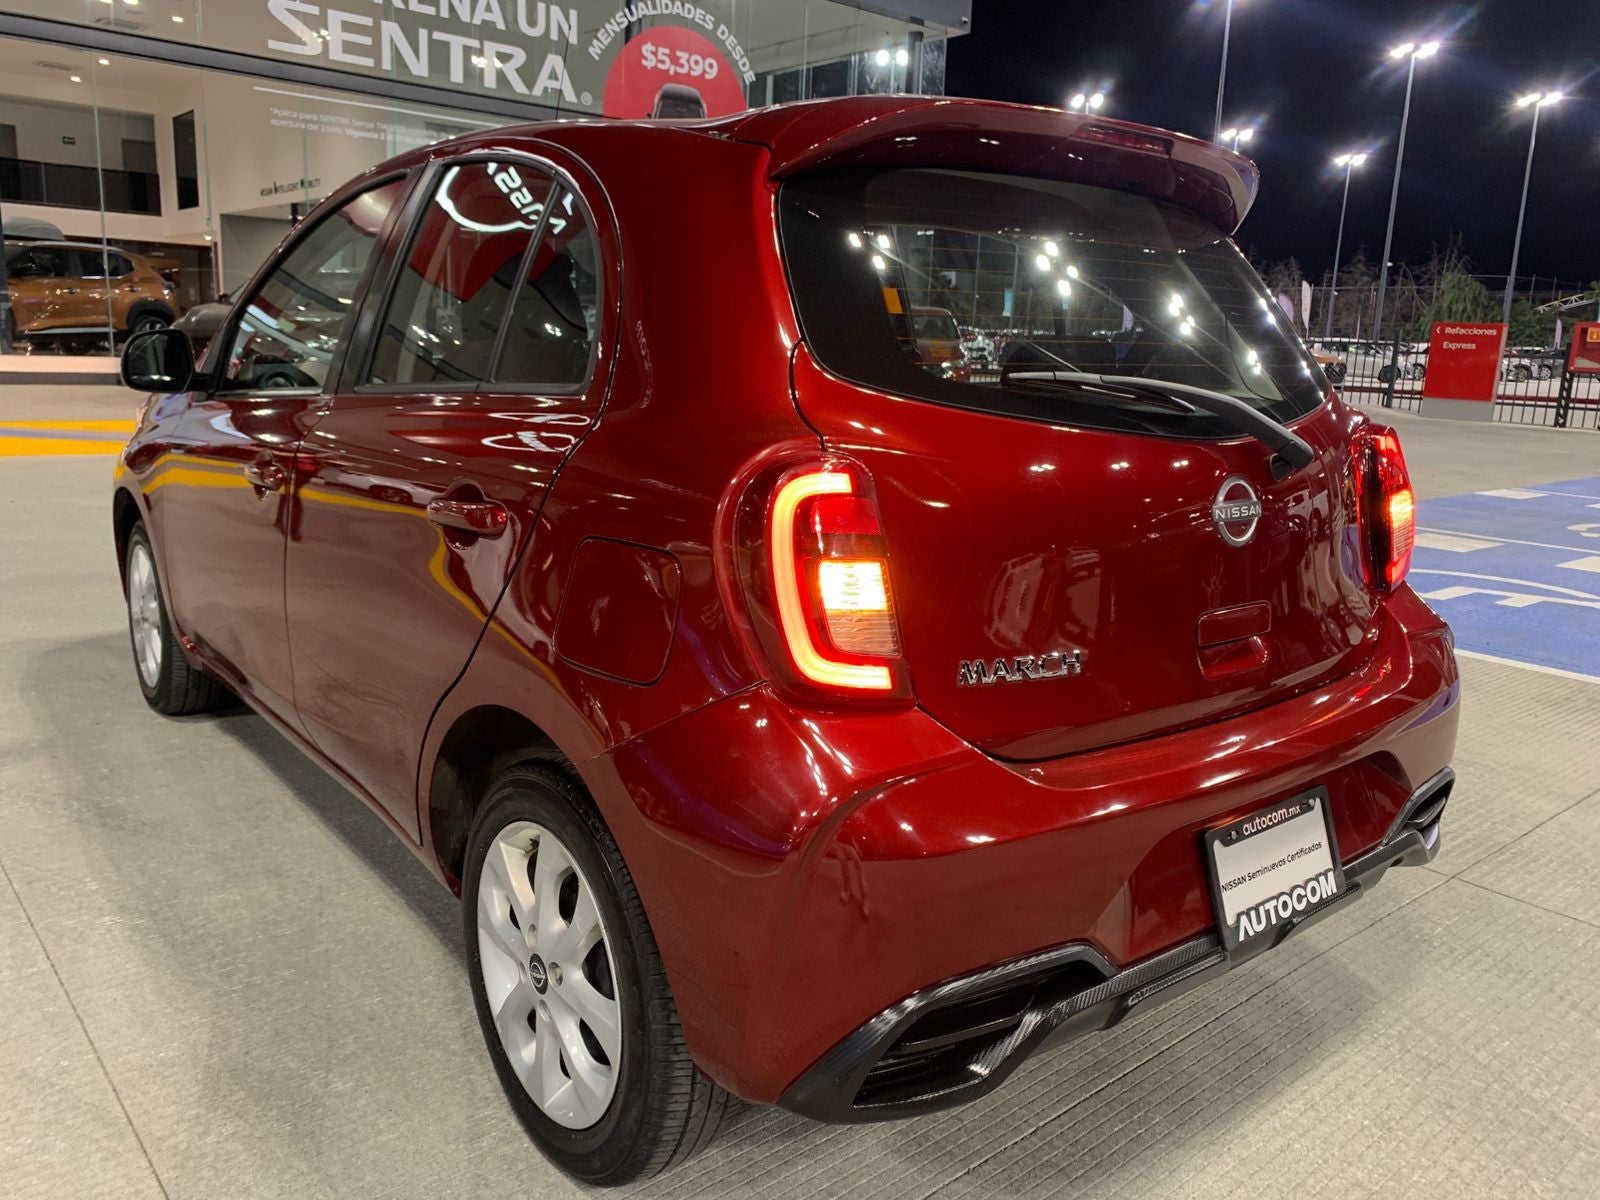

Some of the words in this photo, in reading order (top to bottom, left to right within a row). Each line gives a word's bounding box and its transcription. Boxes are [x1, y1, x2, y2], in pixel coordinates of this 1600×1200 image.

[517, 0, 578, 44] UN
[588, 0, 715, 60] MENSUALIDADES
[716, 24, 756, 85] DESDE
[641, 42, 719, 80] $5,399
[1443, 341, 1476, 350] Express
[1445, 326, 1497, 336] Refacciones
[1215, 504, 1262, 520] NISSAN
[958, 649, 1081, 687] MARCH
[1242, 804, 1301, 836] autocom.mx
[1221, 875, 1247, 893] NISSAN
[1247, 858, 1287, 884] Seminuevos
[1286, 841, 1323, 867] Certificados
[1238, 870, 1337, 942] AUTOCOM
